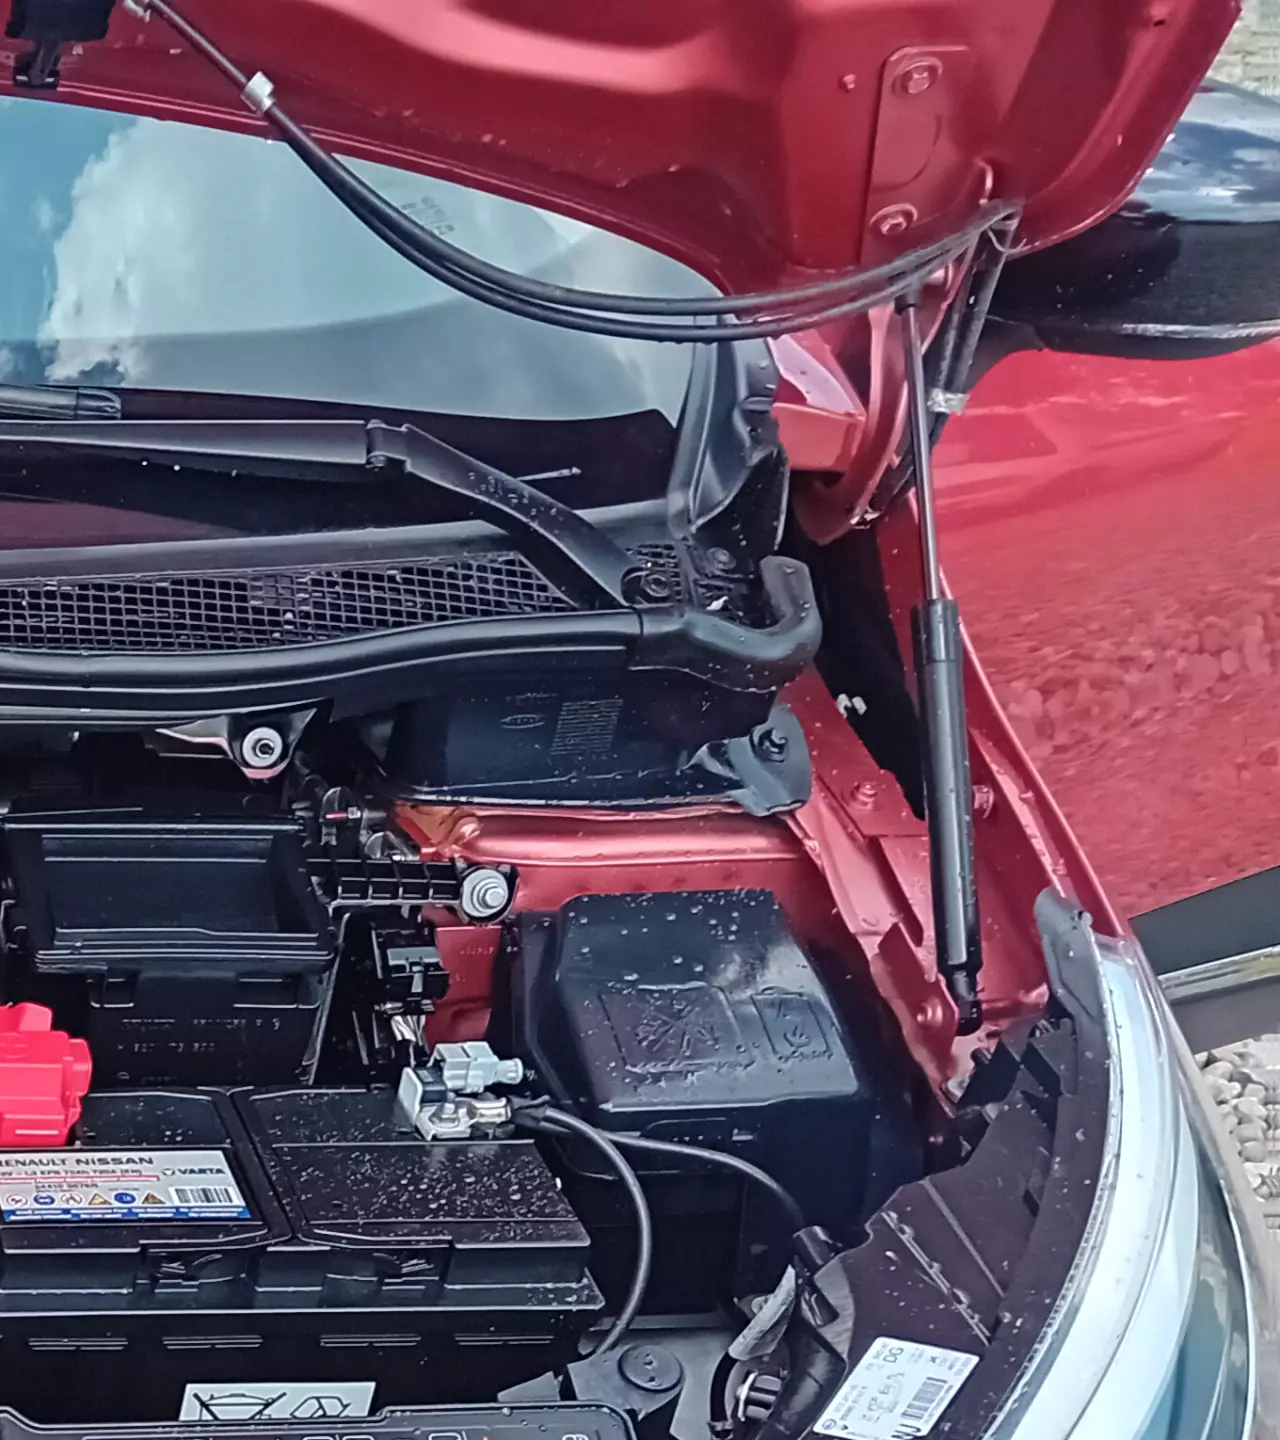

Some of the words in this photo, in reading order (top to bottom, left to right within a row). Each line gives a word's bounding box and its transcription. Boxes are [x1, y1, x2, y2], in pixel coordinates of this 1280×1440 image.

[75, 1156, 154, 1166] NISSAN
[178, 1167, 226, 1176] VARTA
[882, 1347, 905, 1364] DG
